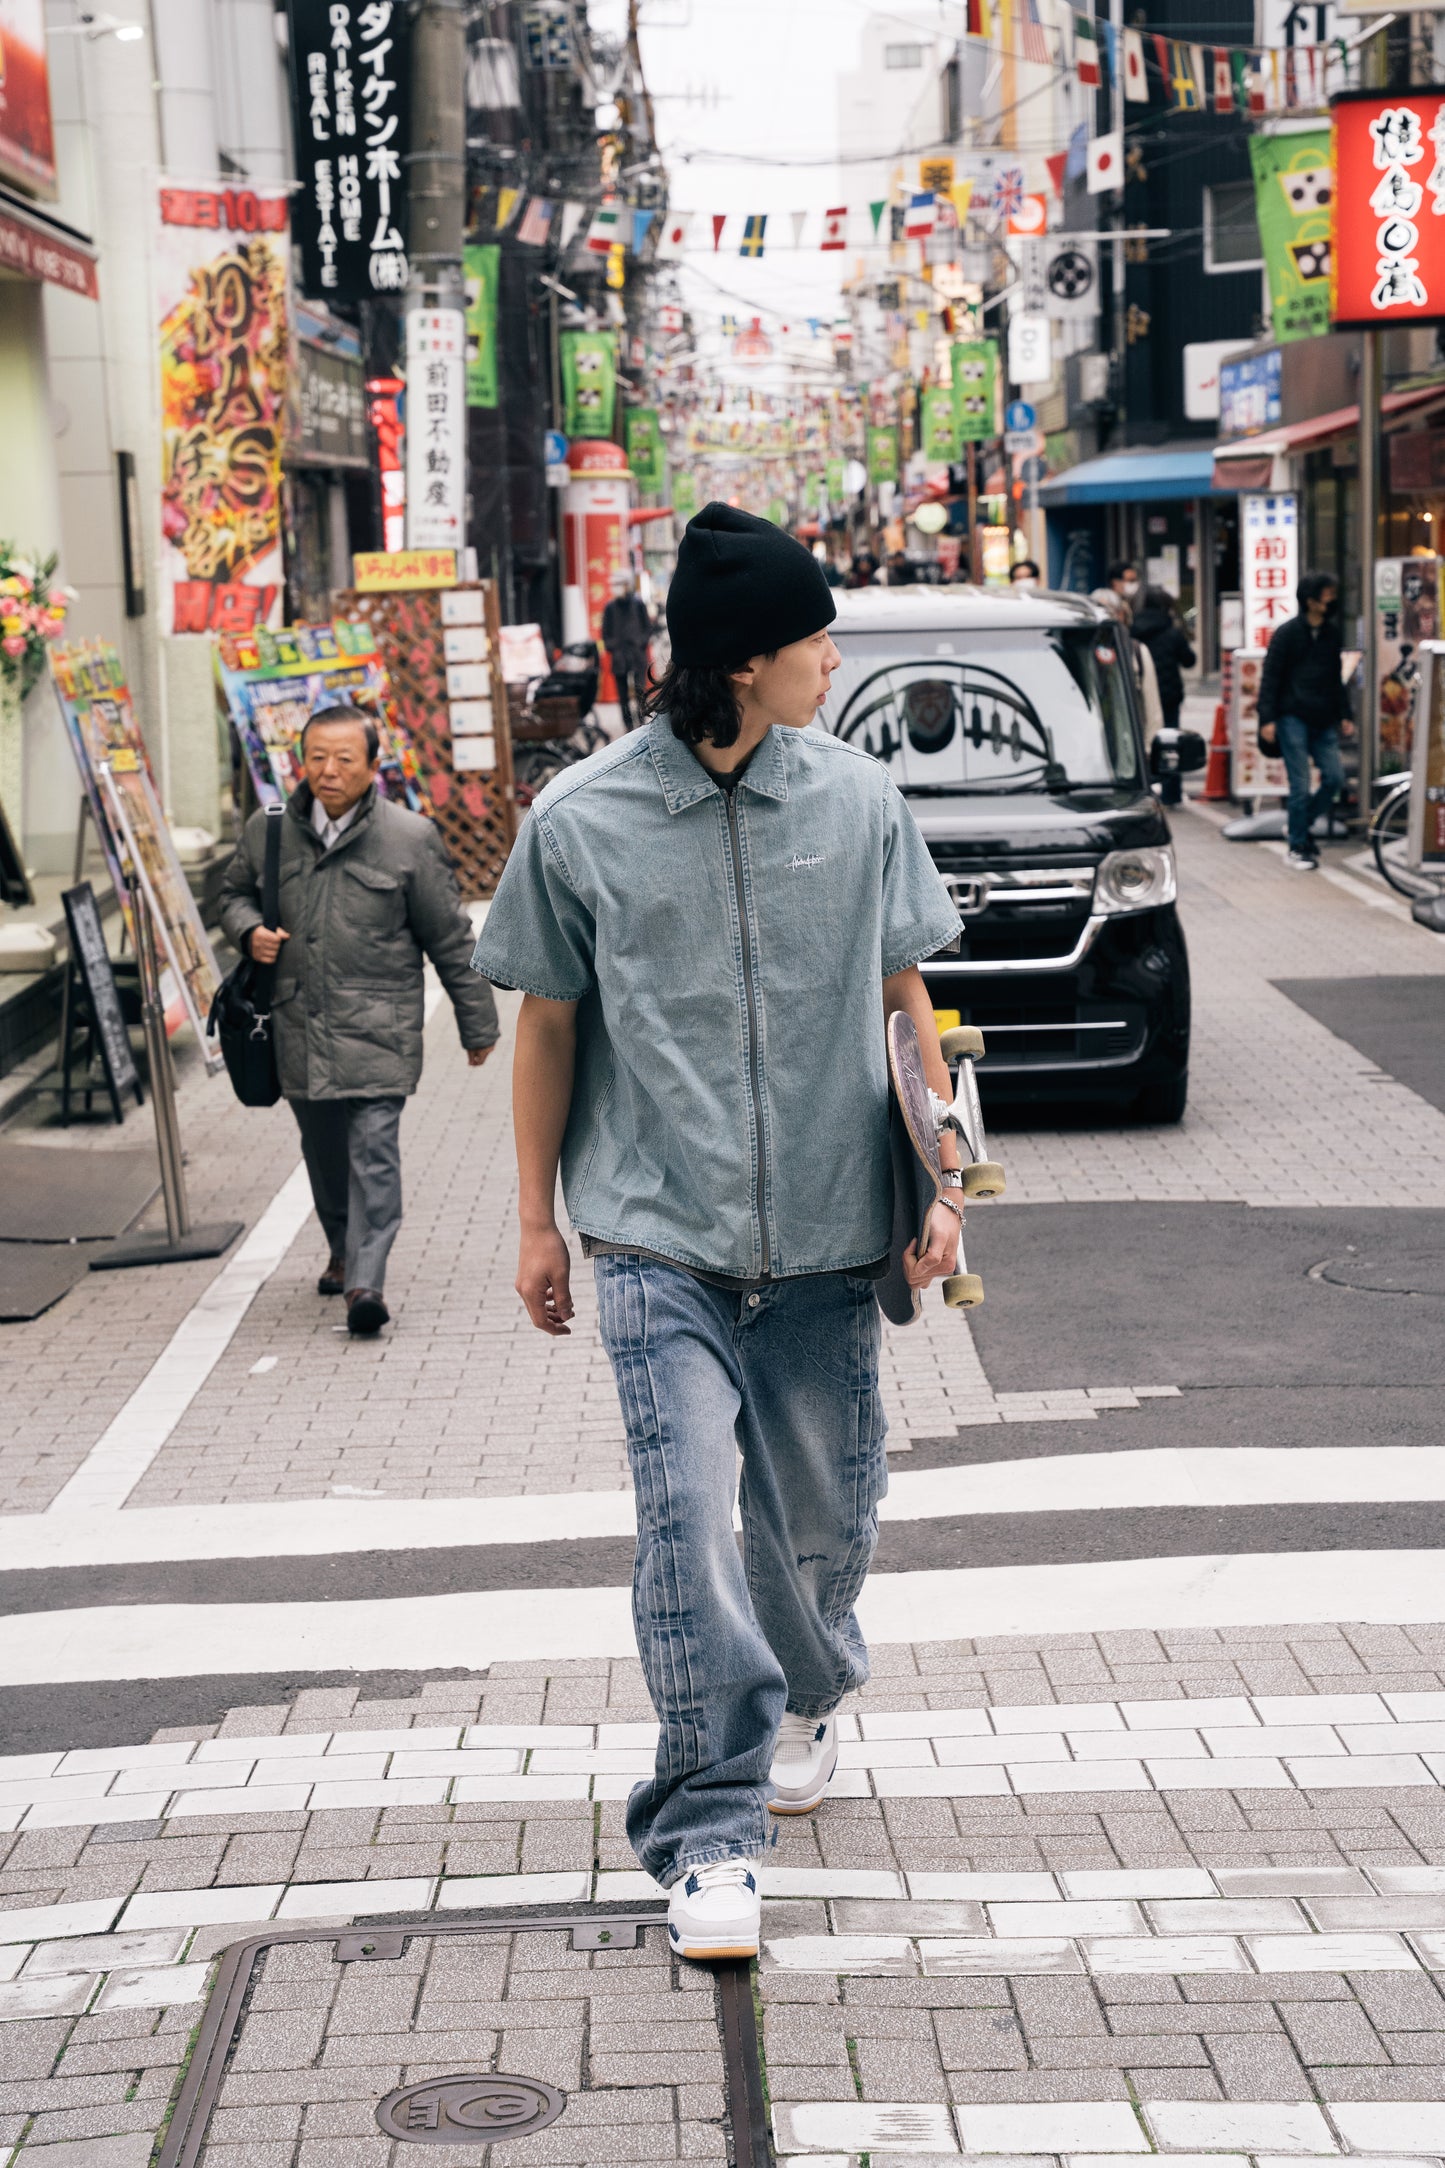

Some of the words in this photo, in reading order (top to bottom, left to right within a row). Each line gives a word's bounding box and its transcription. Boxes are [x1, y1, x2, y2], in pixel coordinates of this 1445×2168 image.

[306, 51, 331, 141] REAL
[328, 2, 356, 137] DAIKEN
[314, 158, 339, 288] ESTATE
[337, 153, 362, 242] HOME
